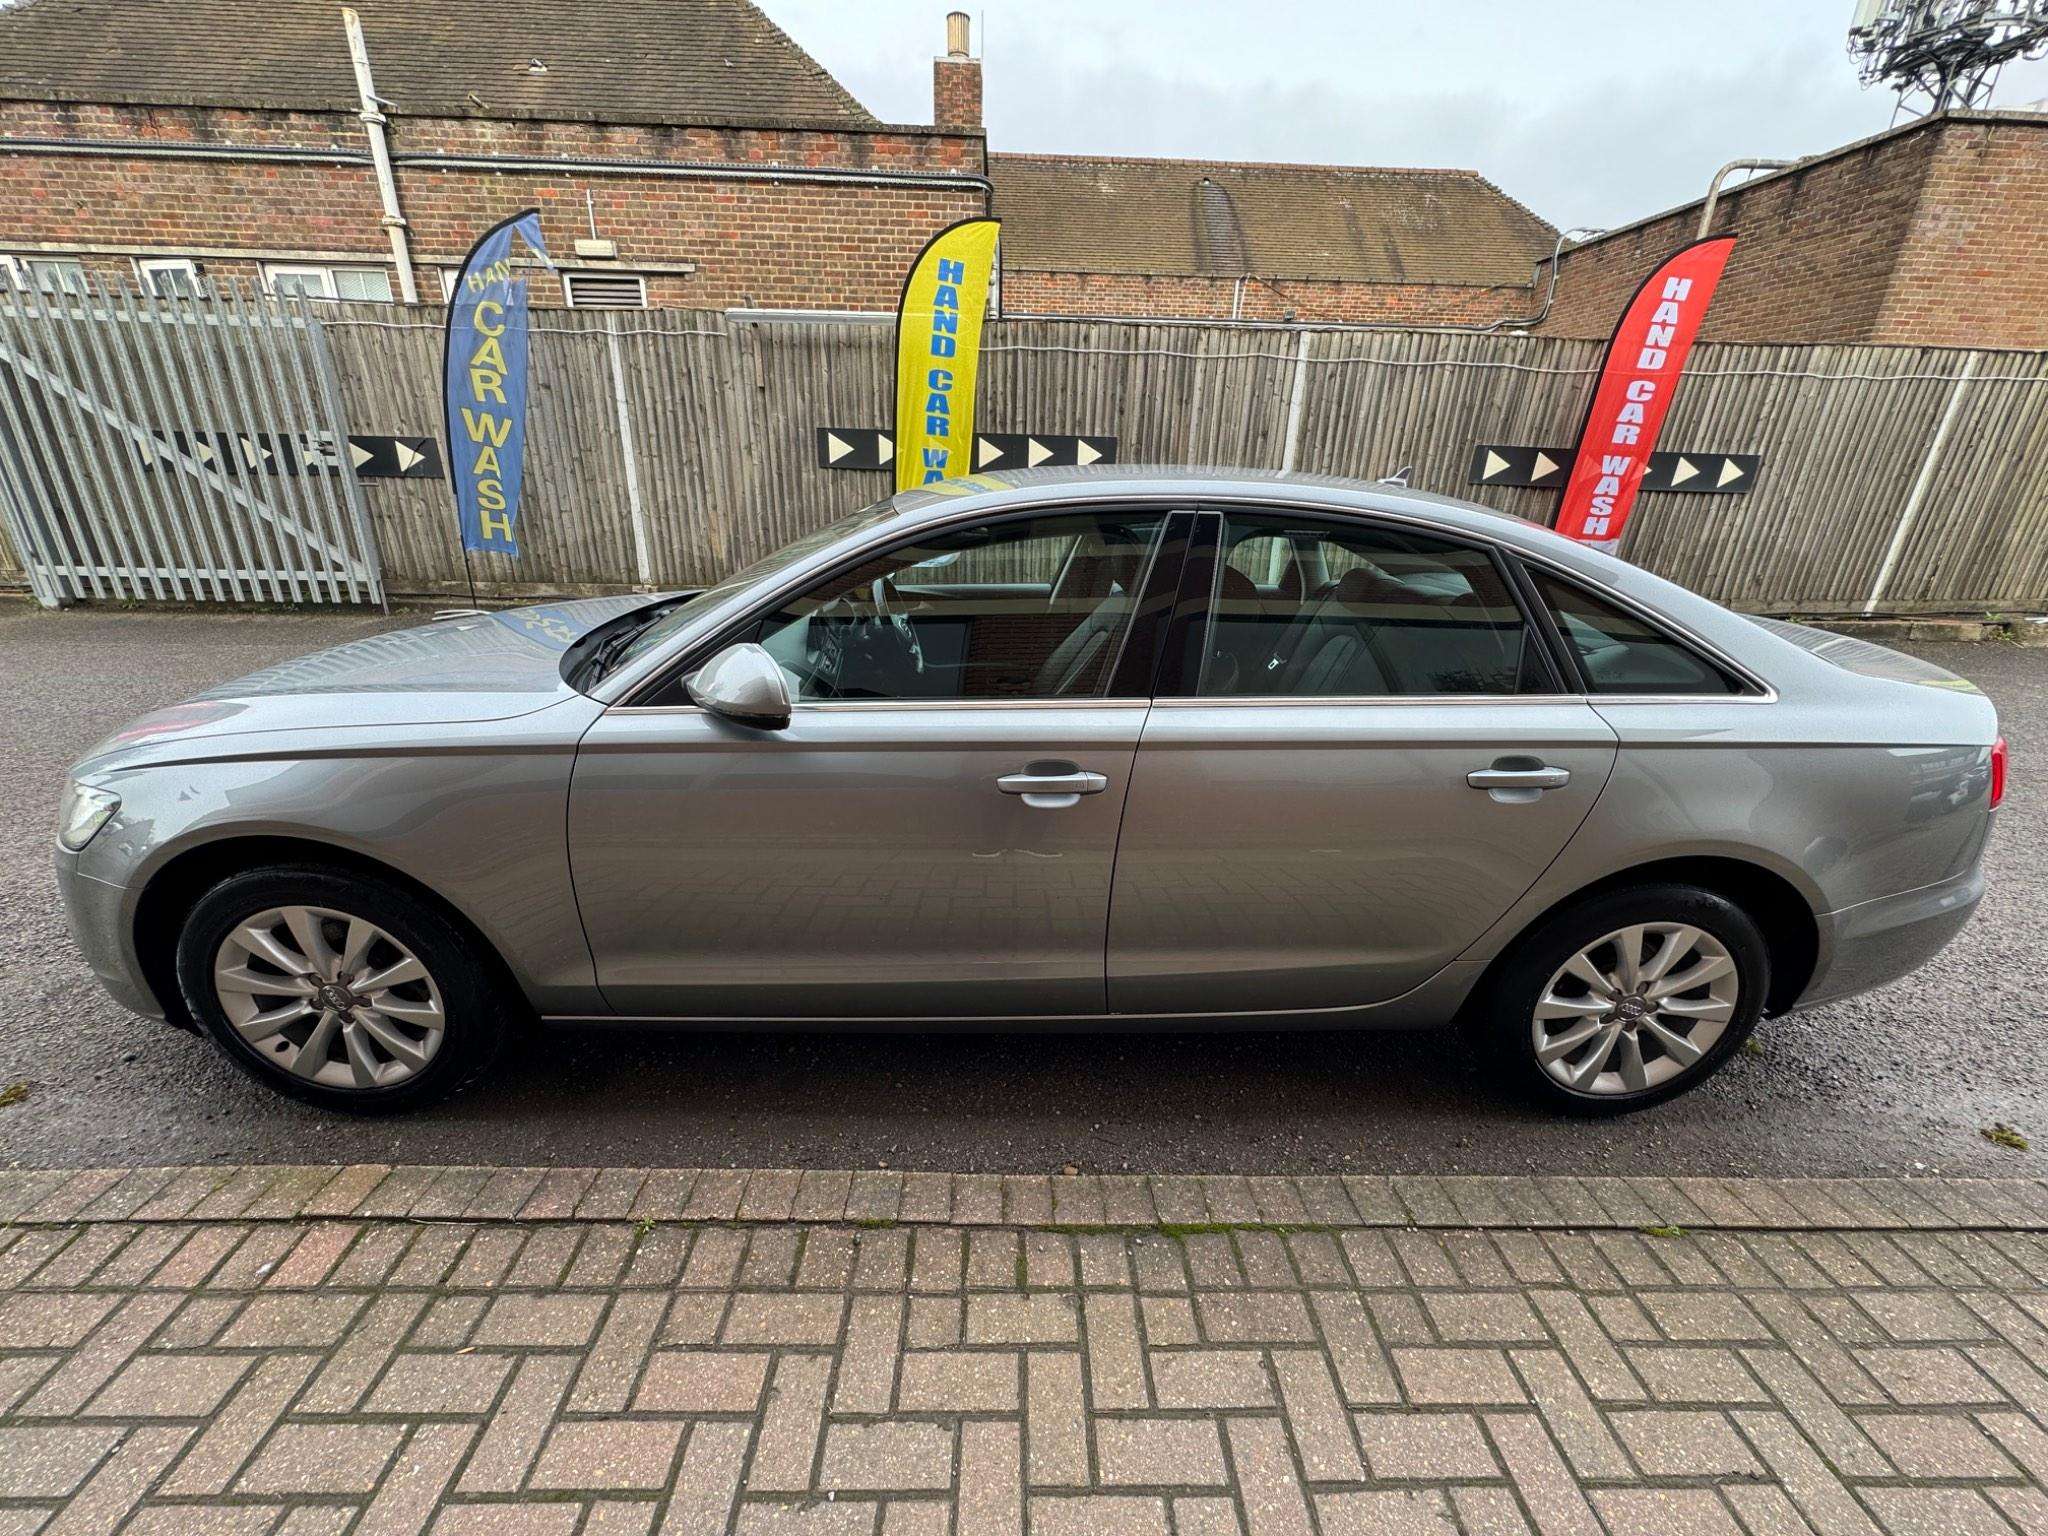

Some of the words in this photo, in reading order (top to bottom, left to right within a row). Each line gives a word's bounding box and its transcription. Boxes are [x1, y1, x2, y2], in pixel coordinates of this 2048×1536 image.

[470, 300, 508, 404] CAR
[931, 258, 965, 358] HAND
[1636, 276, 1693, 370] HAND
[926, 369, 953, 437] CAR
[1611, 380, 1656, 445] CAR
[461, 407, 512, 542] WASH
[1582, 454, 1632, 536] WASH
